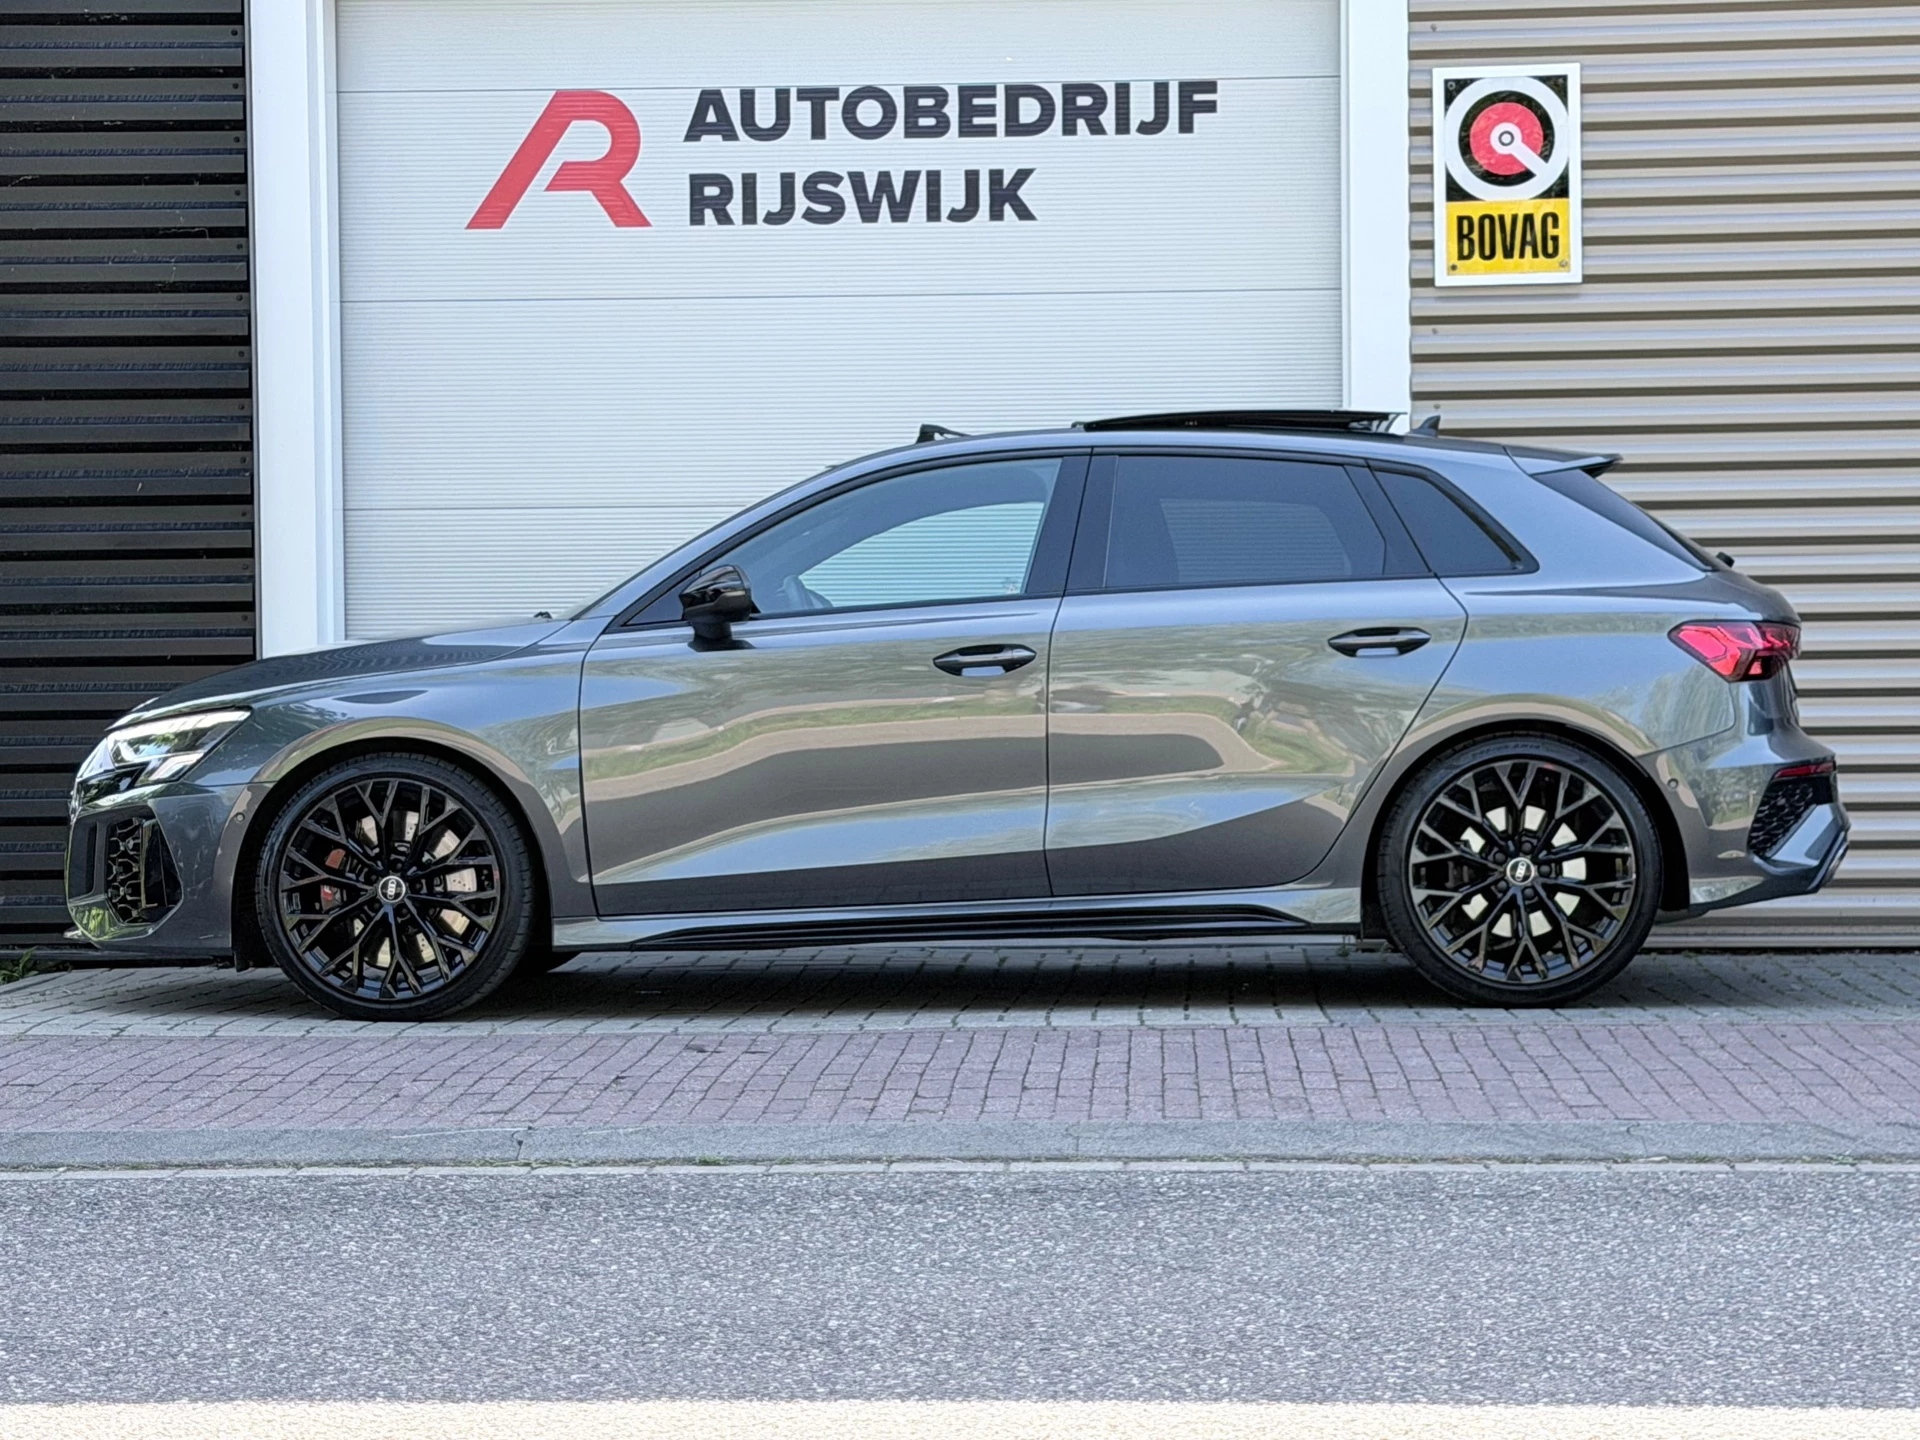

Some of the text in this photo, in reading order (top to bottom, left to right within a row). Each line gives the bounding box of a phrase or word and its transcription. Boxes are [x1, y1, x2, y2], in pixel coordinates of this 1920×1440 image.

[683, 80, 1218, 142] AUTOBEDRIJF
[689, 168, 1037, 226] RIJSWIJK
[1456, 212, 1560, 261] BOVAG
